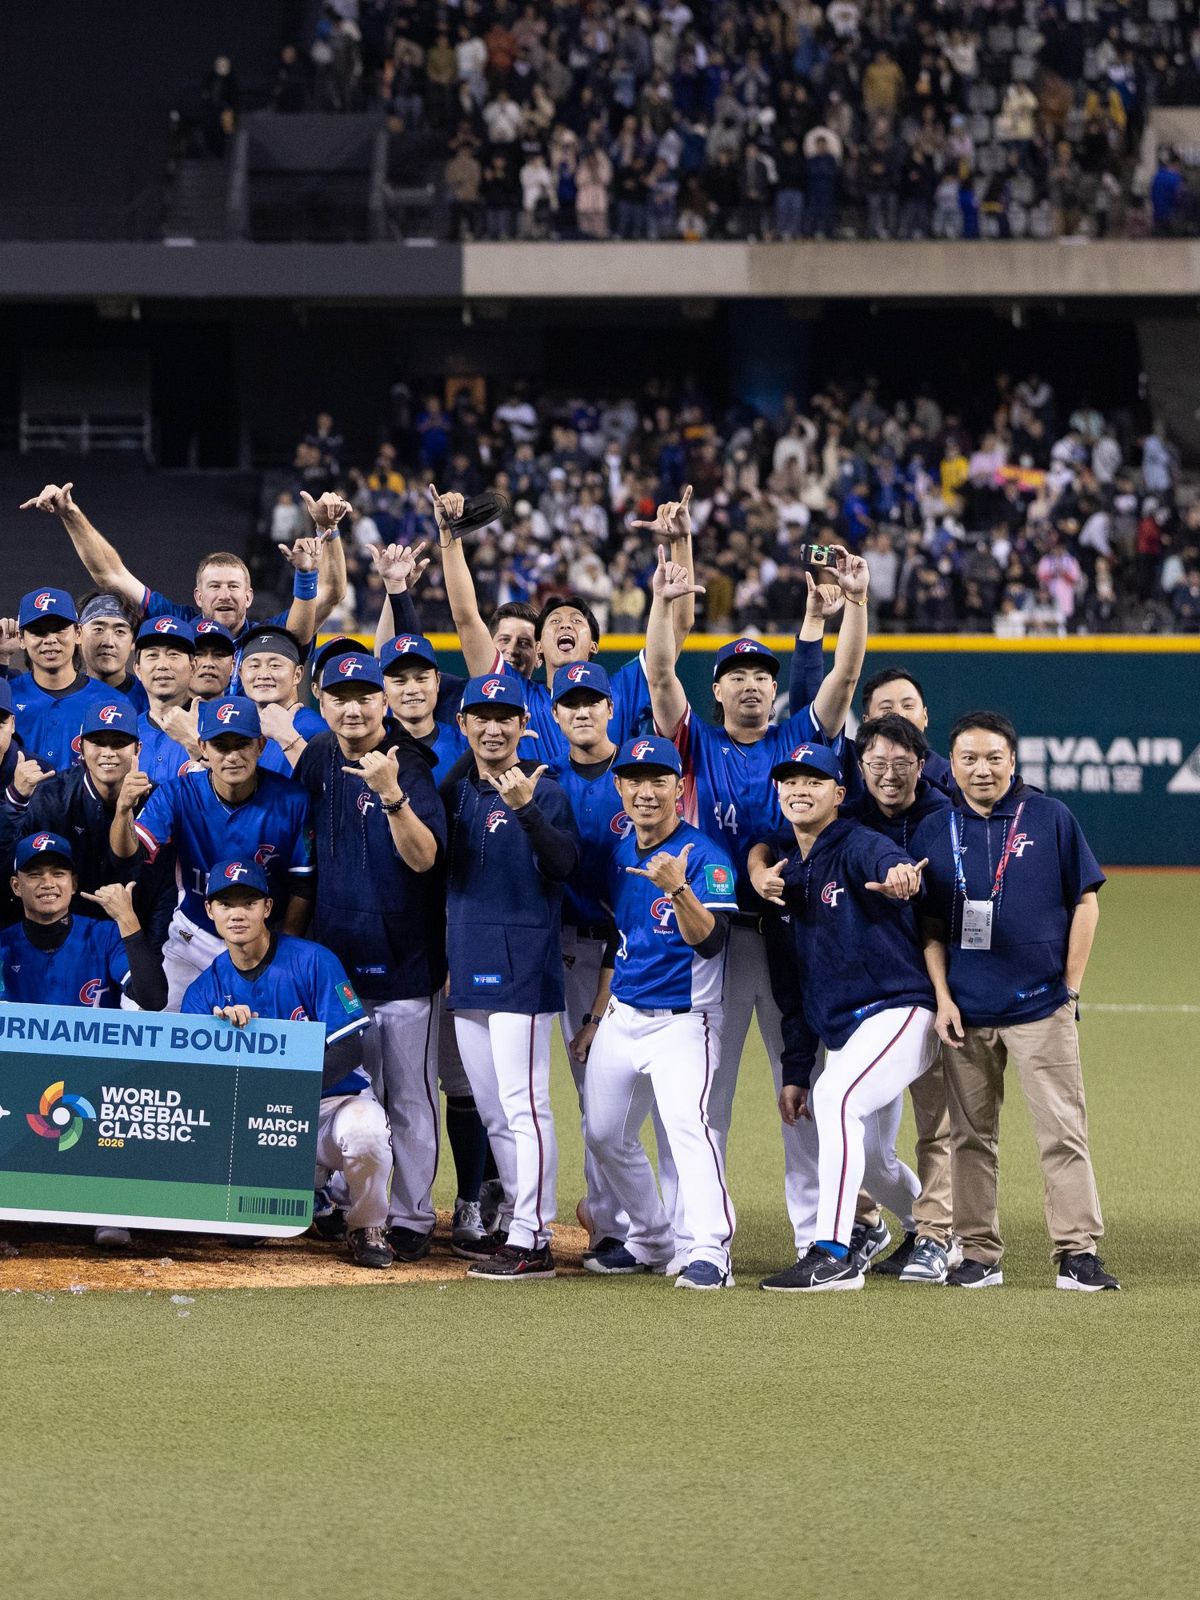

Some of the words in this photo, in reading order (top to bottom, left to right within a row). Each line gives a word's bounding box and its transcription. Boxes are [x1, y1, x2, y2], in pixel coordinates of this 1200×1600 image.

[170, 1027, 287, 1056] BOUND!
[101, 1086, 181, 1107] WORLD
[100, 1103, 211, 1126] BASEBALL
[266, 1104, 293, 1114] DATE
[99, 1120, 192, 1142] CLASSIC
[248, 1117, 309, 1133] MARCH
[98, 1137, 124, 1148] 2026
[258, 1133, 297, 1147] 2026
